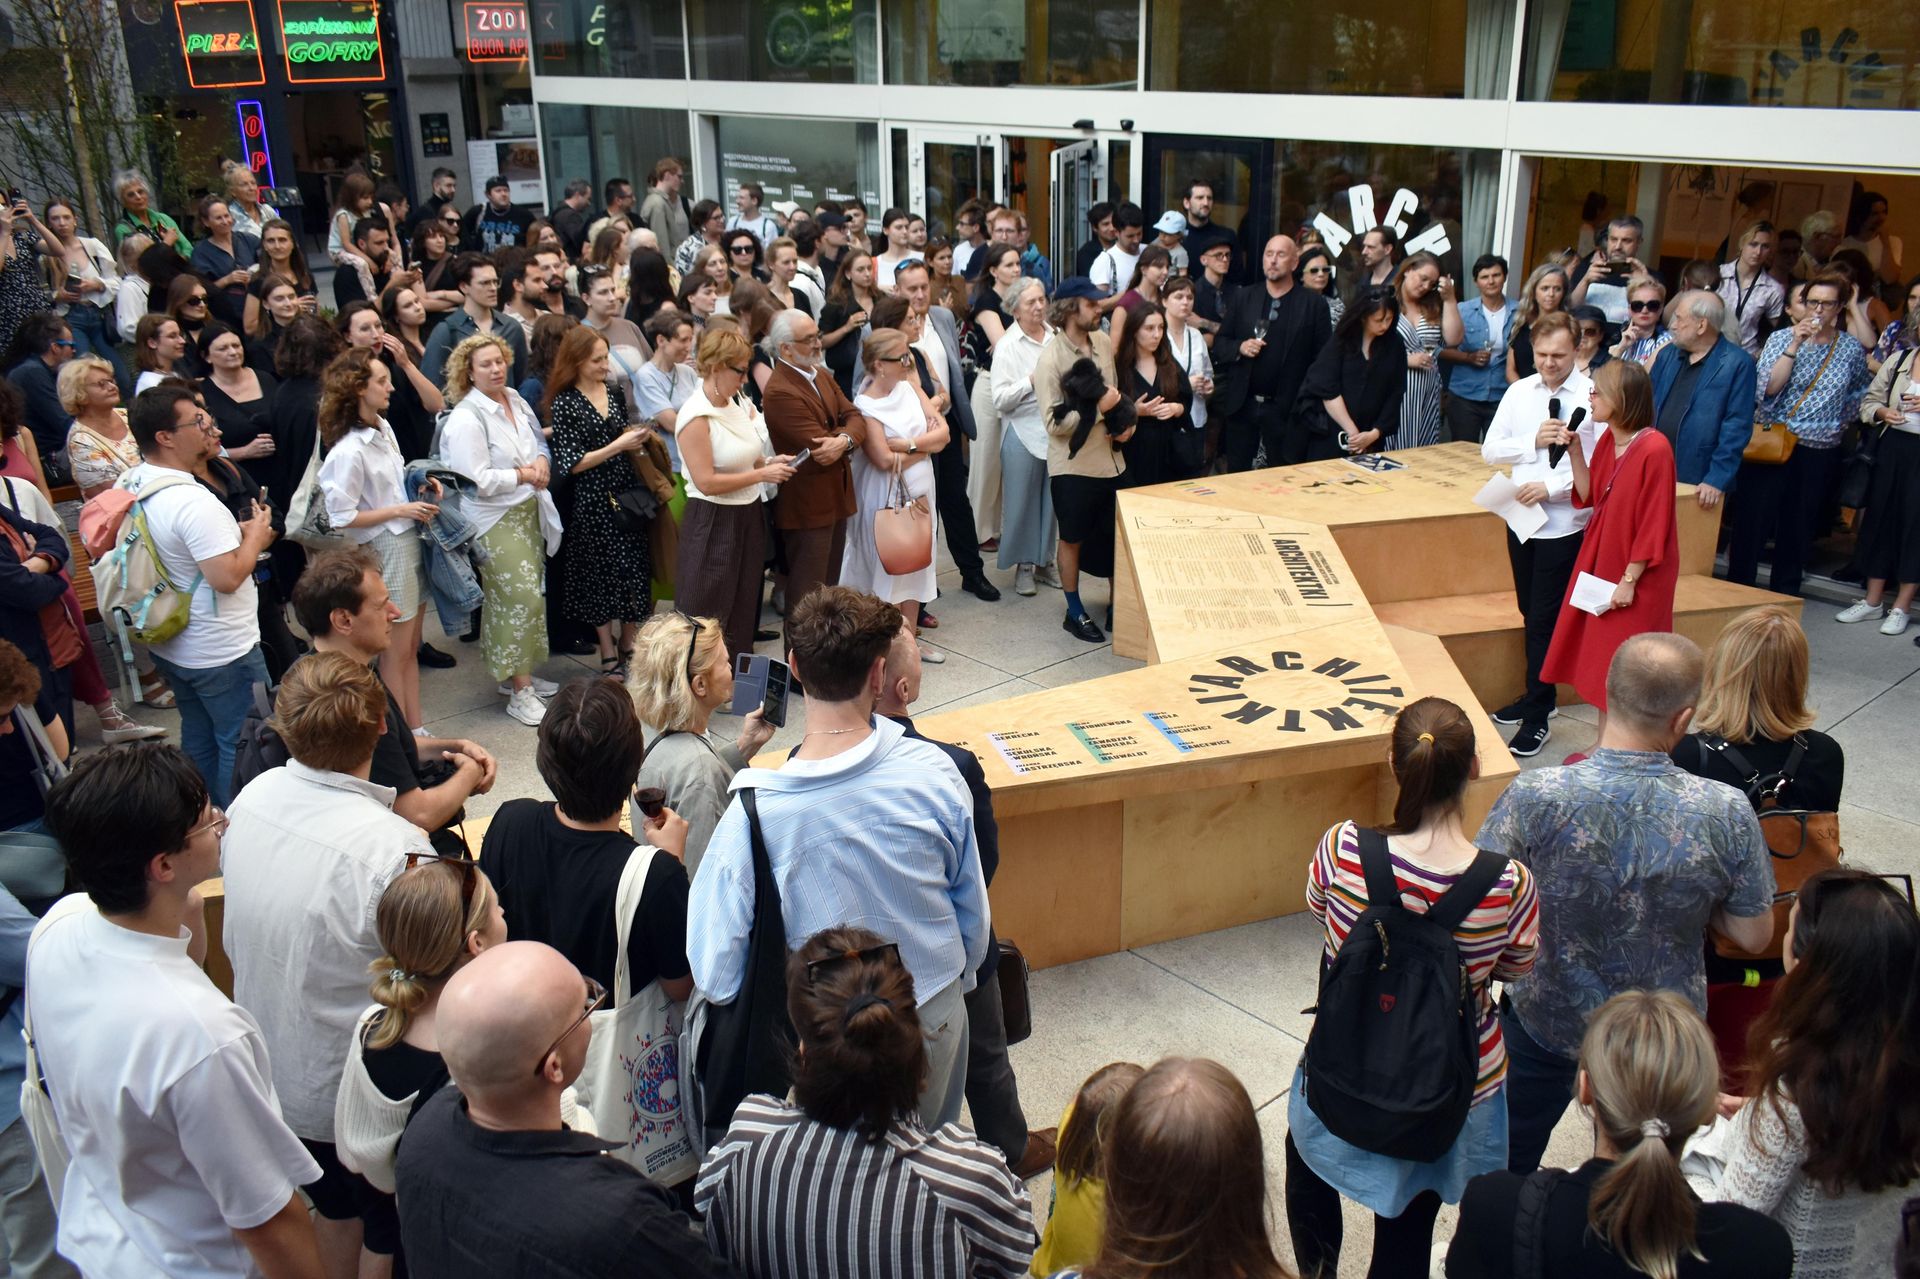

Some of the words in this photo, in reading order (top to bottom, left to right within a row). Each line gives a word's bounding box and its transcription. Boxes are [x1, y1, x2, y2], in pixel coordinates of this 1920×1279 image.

[187, 33, 258, 53] PIZZA
[471, 38, 504, 55] BUON
[288, 41, 379, 63] GOFRY
[480, 221, 521, 234] oasis
[1271, 538, 1330, 600] ARCHITEKTKI
[1074, 720, 1133, 731] SKIBNIEWSKA
[1165, 725, 1213, 735] KUCIEWICZ
[994, 731, 1040, 741] SEKRECKA
